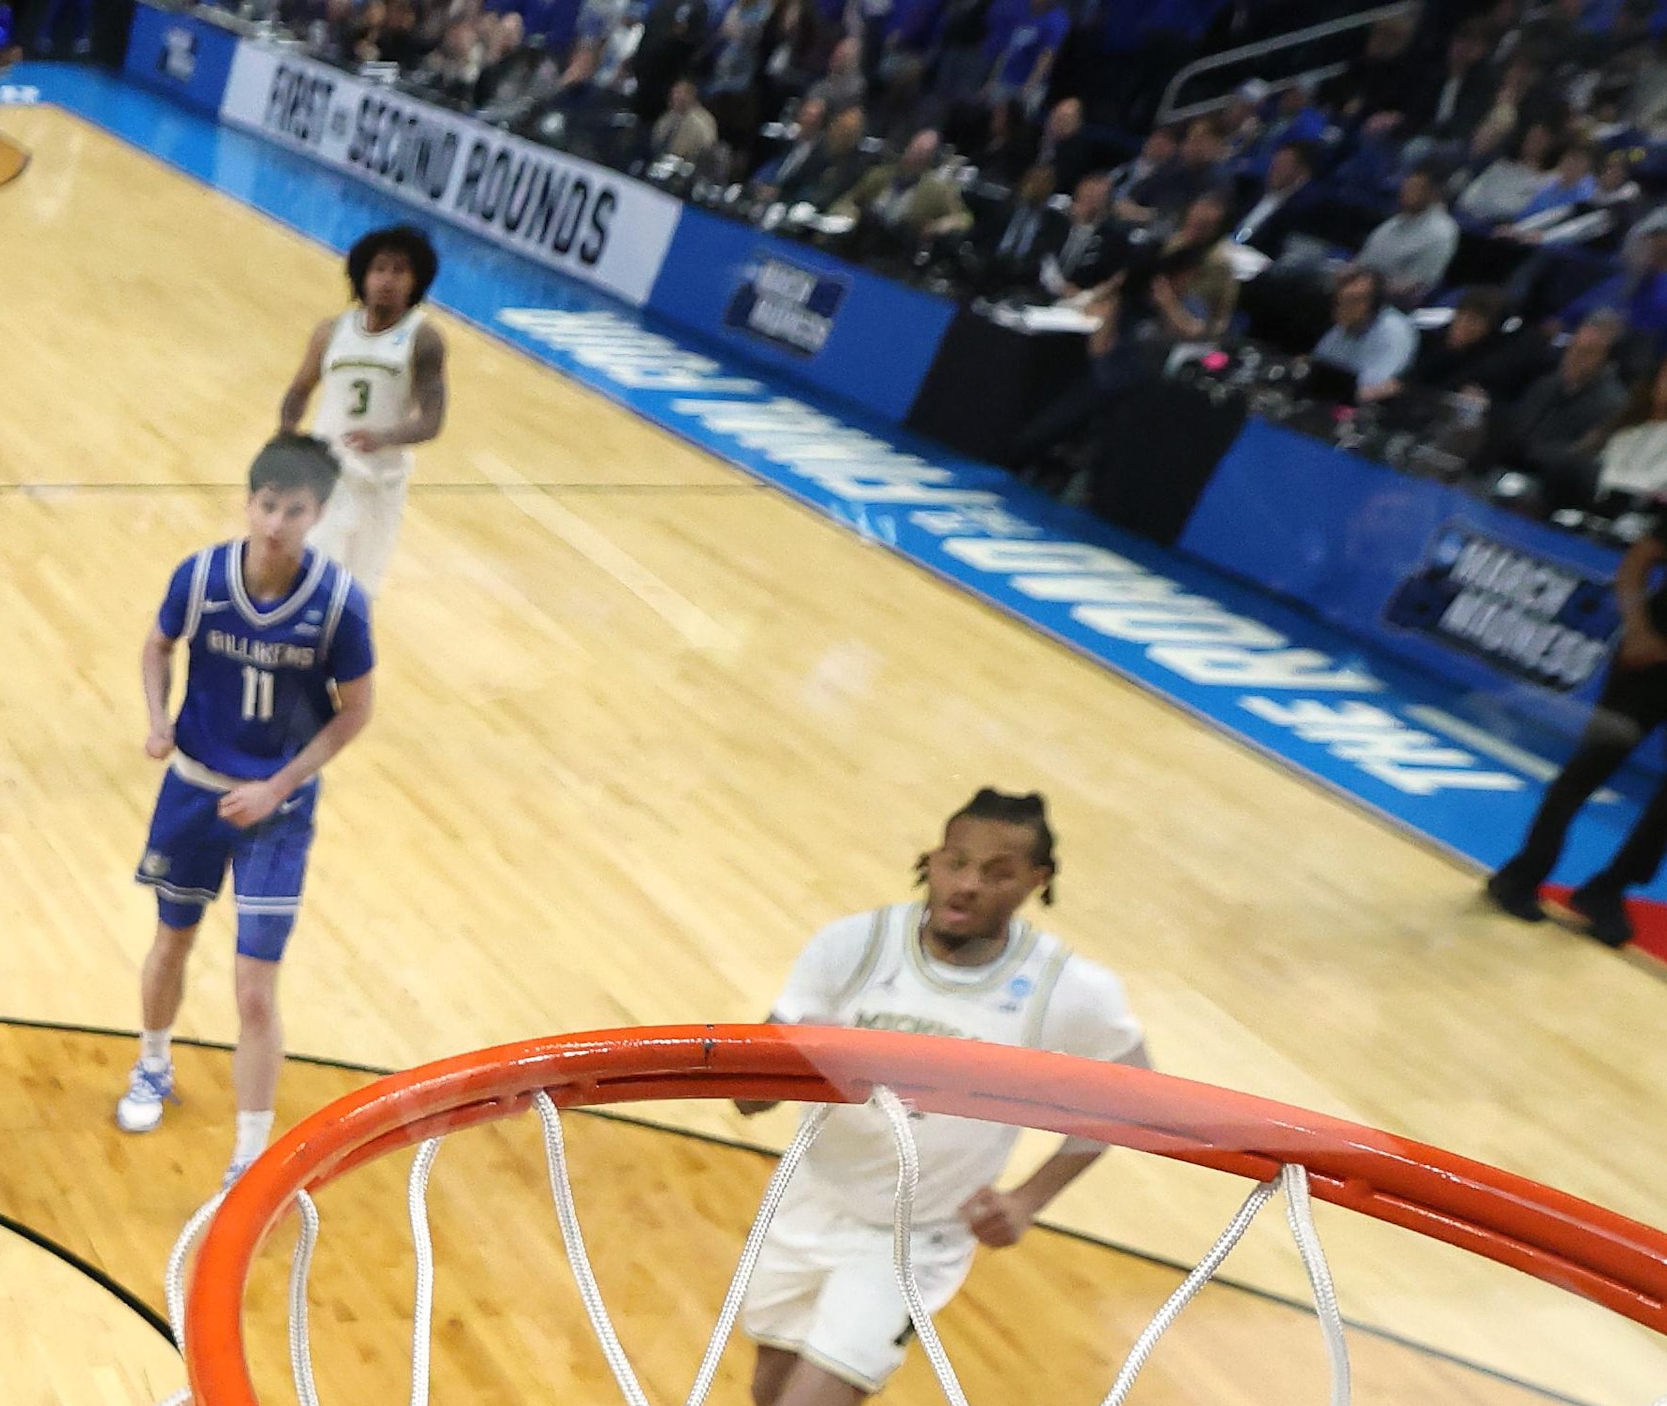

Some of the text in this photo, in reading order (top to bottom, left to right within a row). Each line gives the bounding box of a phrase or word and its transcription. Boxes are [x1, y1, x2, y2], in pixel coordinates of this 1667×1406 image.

[459, 135, 620, 266] ROUNDS
[348, 378, 370, 417] 3
[941, 536, 1386, 693] ROAD
[241, 665, 275, 721] 11
